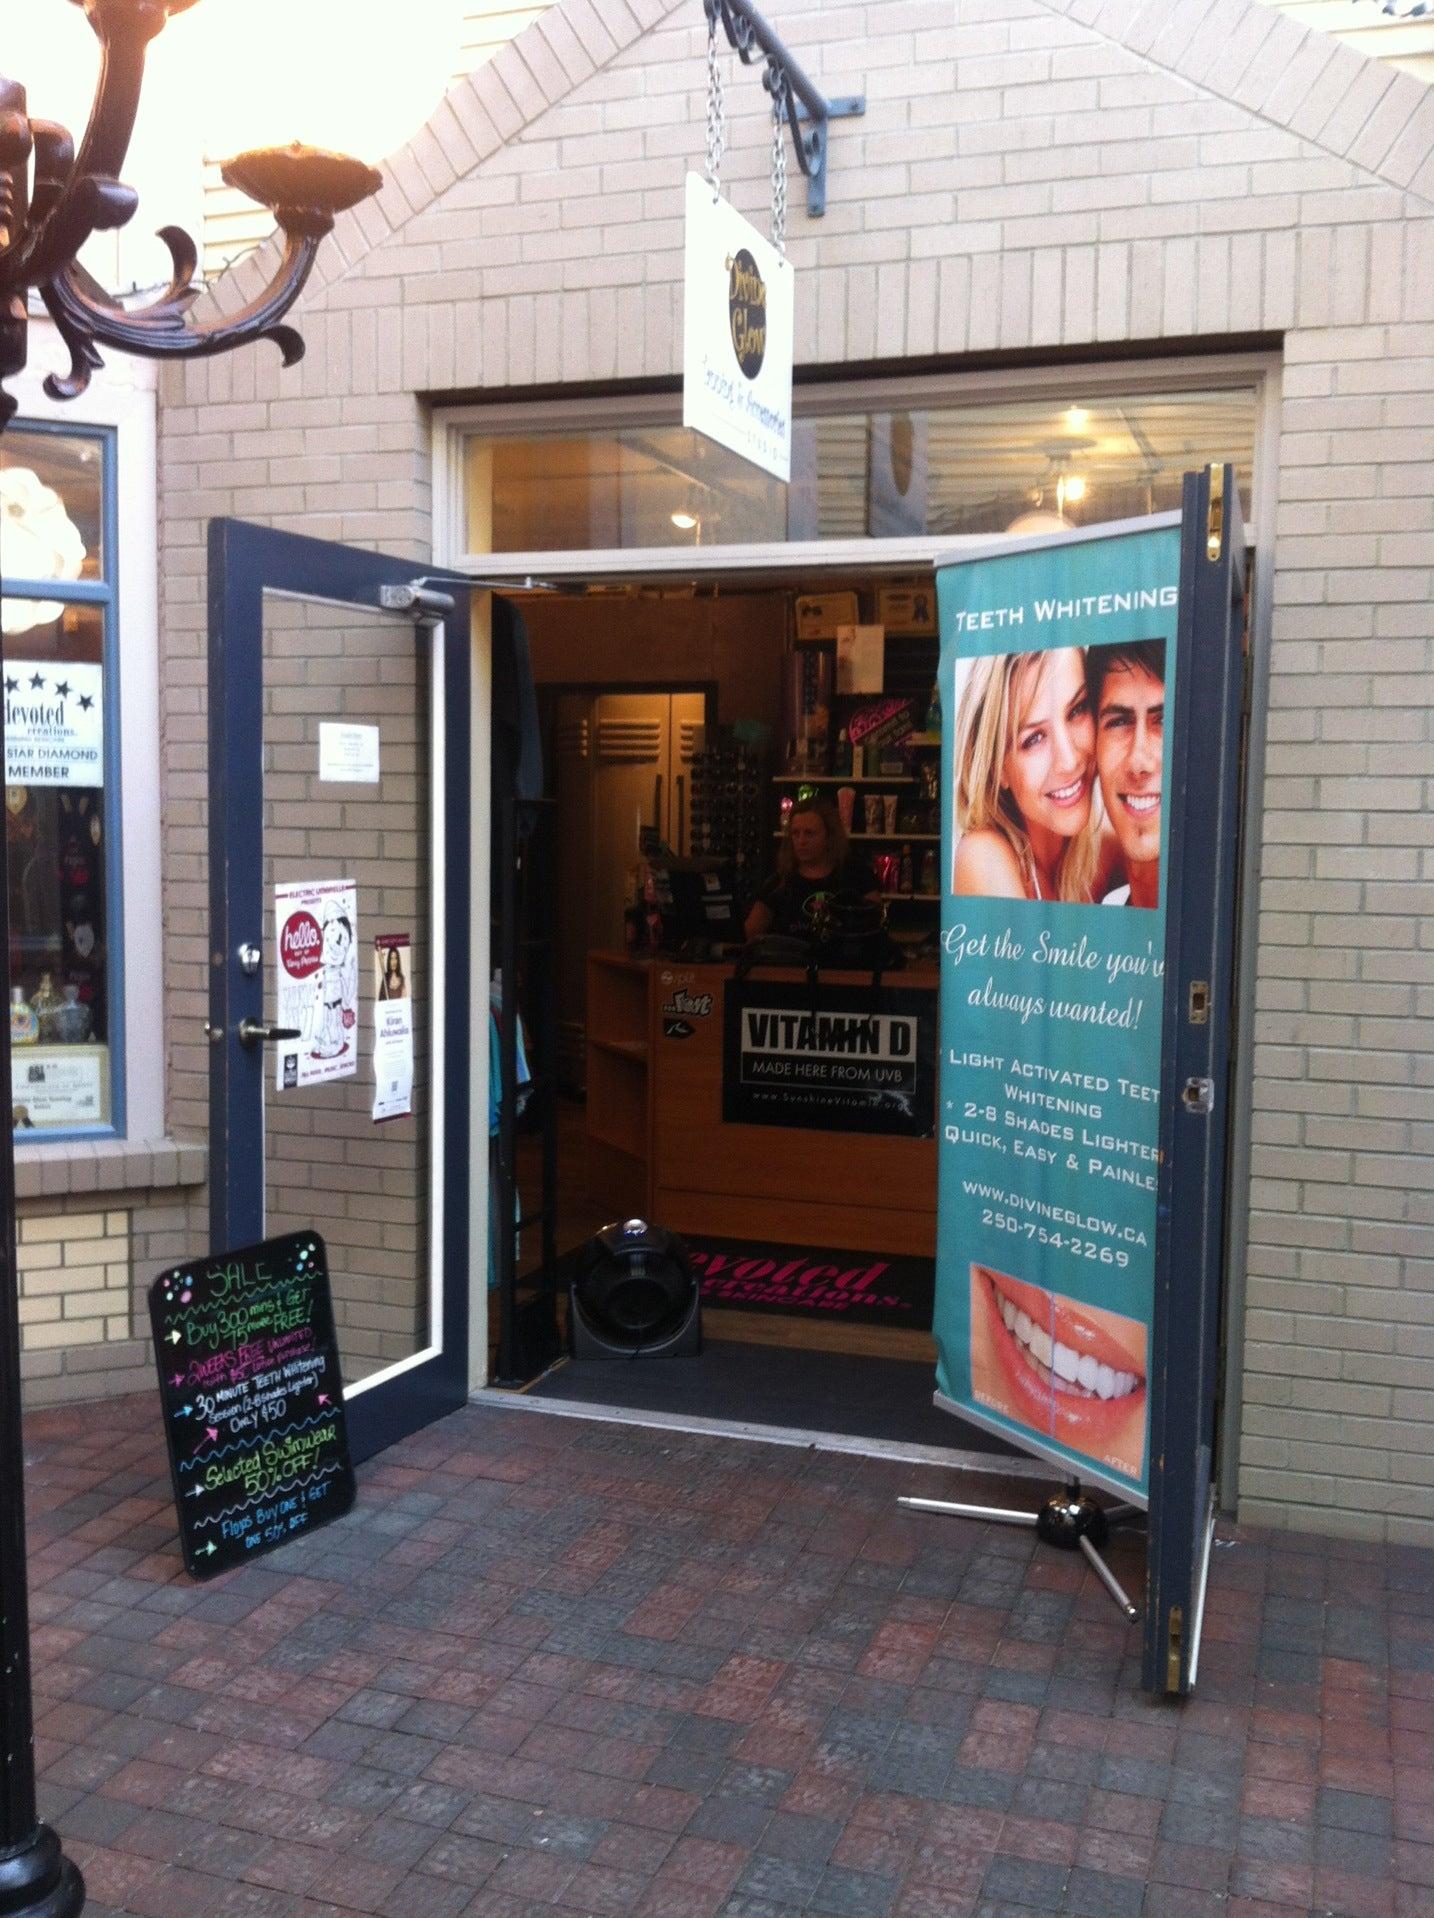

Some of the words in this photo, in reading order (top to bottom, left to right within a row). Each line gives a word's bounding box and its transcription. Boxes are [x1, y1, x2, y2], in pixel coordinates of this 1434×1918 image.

[956, 606, 1024, 632] TEETH
[1034, 586, 1178, 622] WHITENING
[7, 747, 35, 760] STAR
[38, 748, 98, 761] DIAMOND
[8, 765, 70, 779] MEMBER
[941, 923, 989, 966] Get
[994, 927, 1025, 960] the
[1032, 930, 1103, 970] Smile
[968, 976, 1046, 1025] always
[1049, 998, 1143, 1030] wanted!
[747, 1013, 880, 1055] VITAMIN
[889, 1021, 911, 1056] D
[752, 1062, 792, 1076] MADE
[795, 1063, 828, 1078] HERE
[831, 1066, 871, 1081] FROM
[874, 1068, 903, 1083] UVB
[949, 1049, 1005, 1070] LIGHT
[1010, 1059, 1110, 1092] ACTIVATED
[964, 1102, 997, 1122] 2-8
[1005, 1111, 1075, 1141] SHADES
[1005, 1083, 1103, 1120] WHITENING
[945, 1125, 1008, 1154] QUICK,
[1014, 1139, 1058, 1165] EASY
[1066, 1153, 1079, 1171] &
[1088, 1159, 1159, 1191] PAINLE
[982, 1208, 1130, 1268] 250-754-2269
[206, 1262, 273, 1297] SALE
[187, 1321, 220, 1350] Buy
[217, 1307, 249, 1334] 300
[223, 1326, 249, 1350] 75
[273, 1298, 314, 1334] FREE!
[195, 1393, 216, 1421] 30
[215, 1380, 250, 1402] MINUTE
[251, 1370, 282, 1390] TEETH
[261, 1399, 287, 1422] $50
[204, 1451, 262, 1490] Selected
[244, 1467, 282, 1496] 50%
[282, 1447, 321, 1478] OFF!
